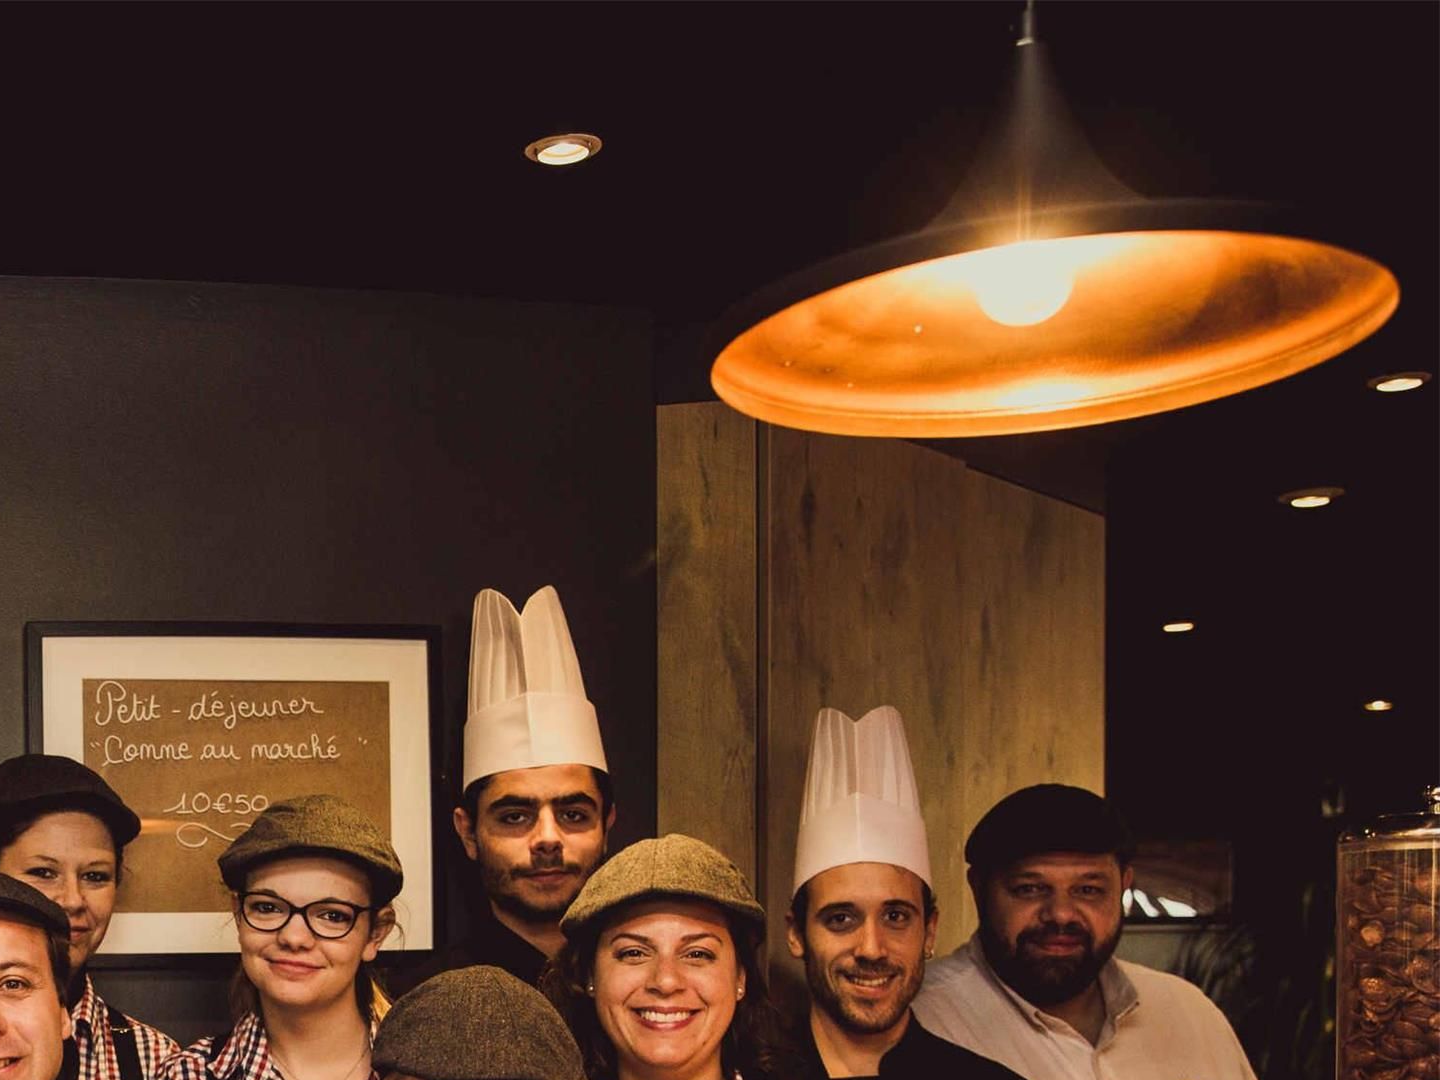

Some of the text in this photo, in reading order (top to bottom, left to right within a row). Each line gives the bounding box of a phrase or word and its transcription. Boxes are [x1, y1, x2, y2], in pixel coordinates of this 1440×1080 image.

[94, 680, 161, 727] Petit
[187, 690, 324, 730] déjeuner
[200, 743, 241, 762] au
[163, 791, 268, 816] 10€50
